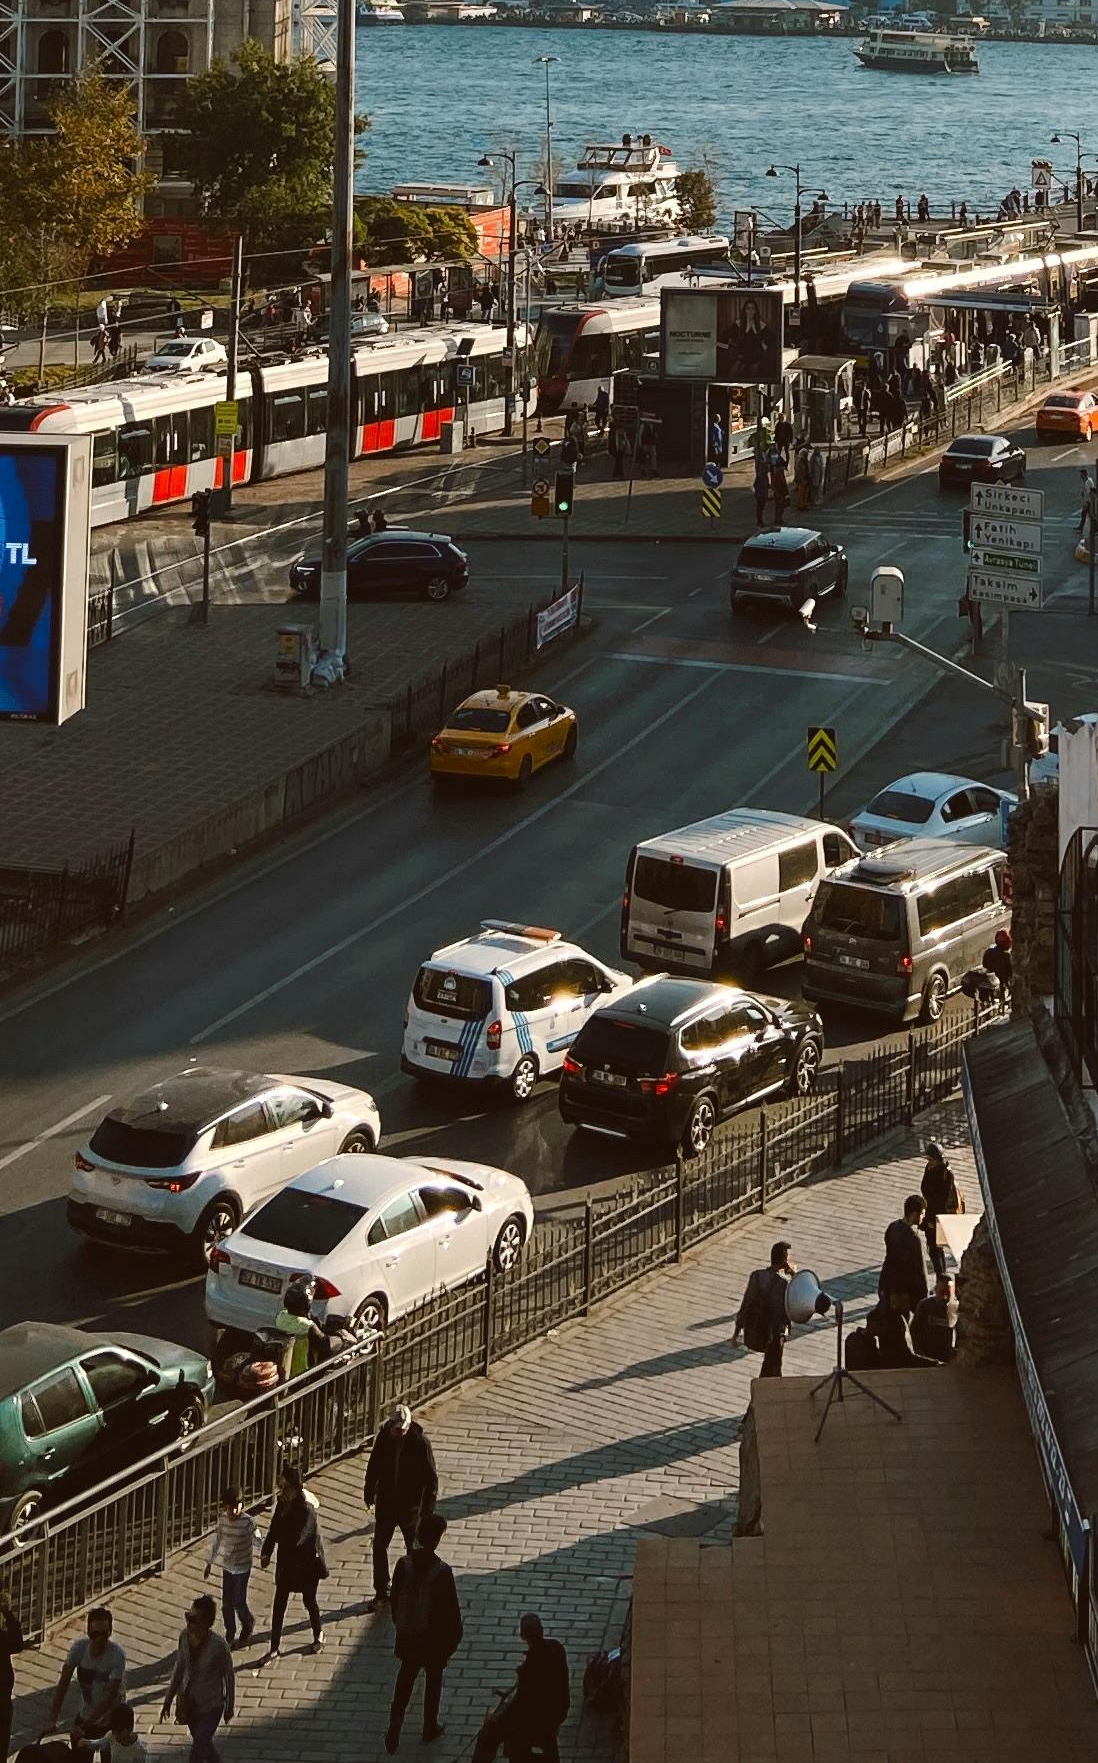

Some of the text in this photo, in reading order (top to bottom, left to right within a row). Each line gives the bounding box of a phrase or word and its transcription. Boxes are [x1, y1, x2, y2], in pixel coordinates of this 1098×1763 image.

[985, 488, 1031, 503] Sirkeci
[984, 521, 1017, 535] Fatih
[5, 542, 37, 564] TL
[973, 575, 1018, 591] Taksim
